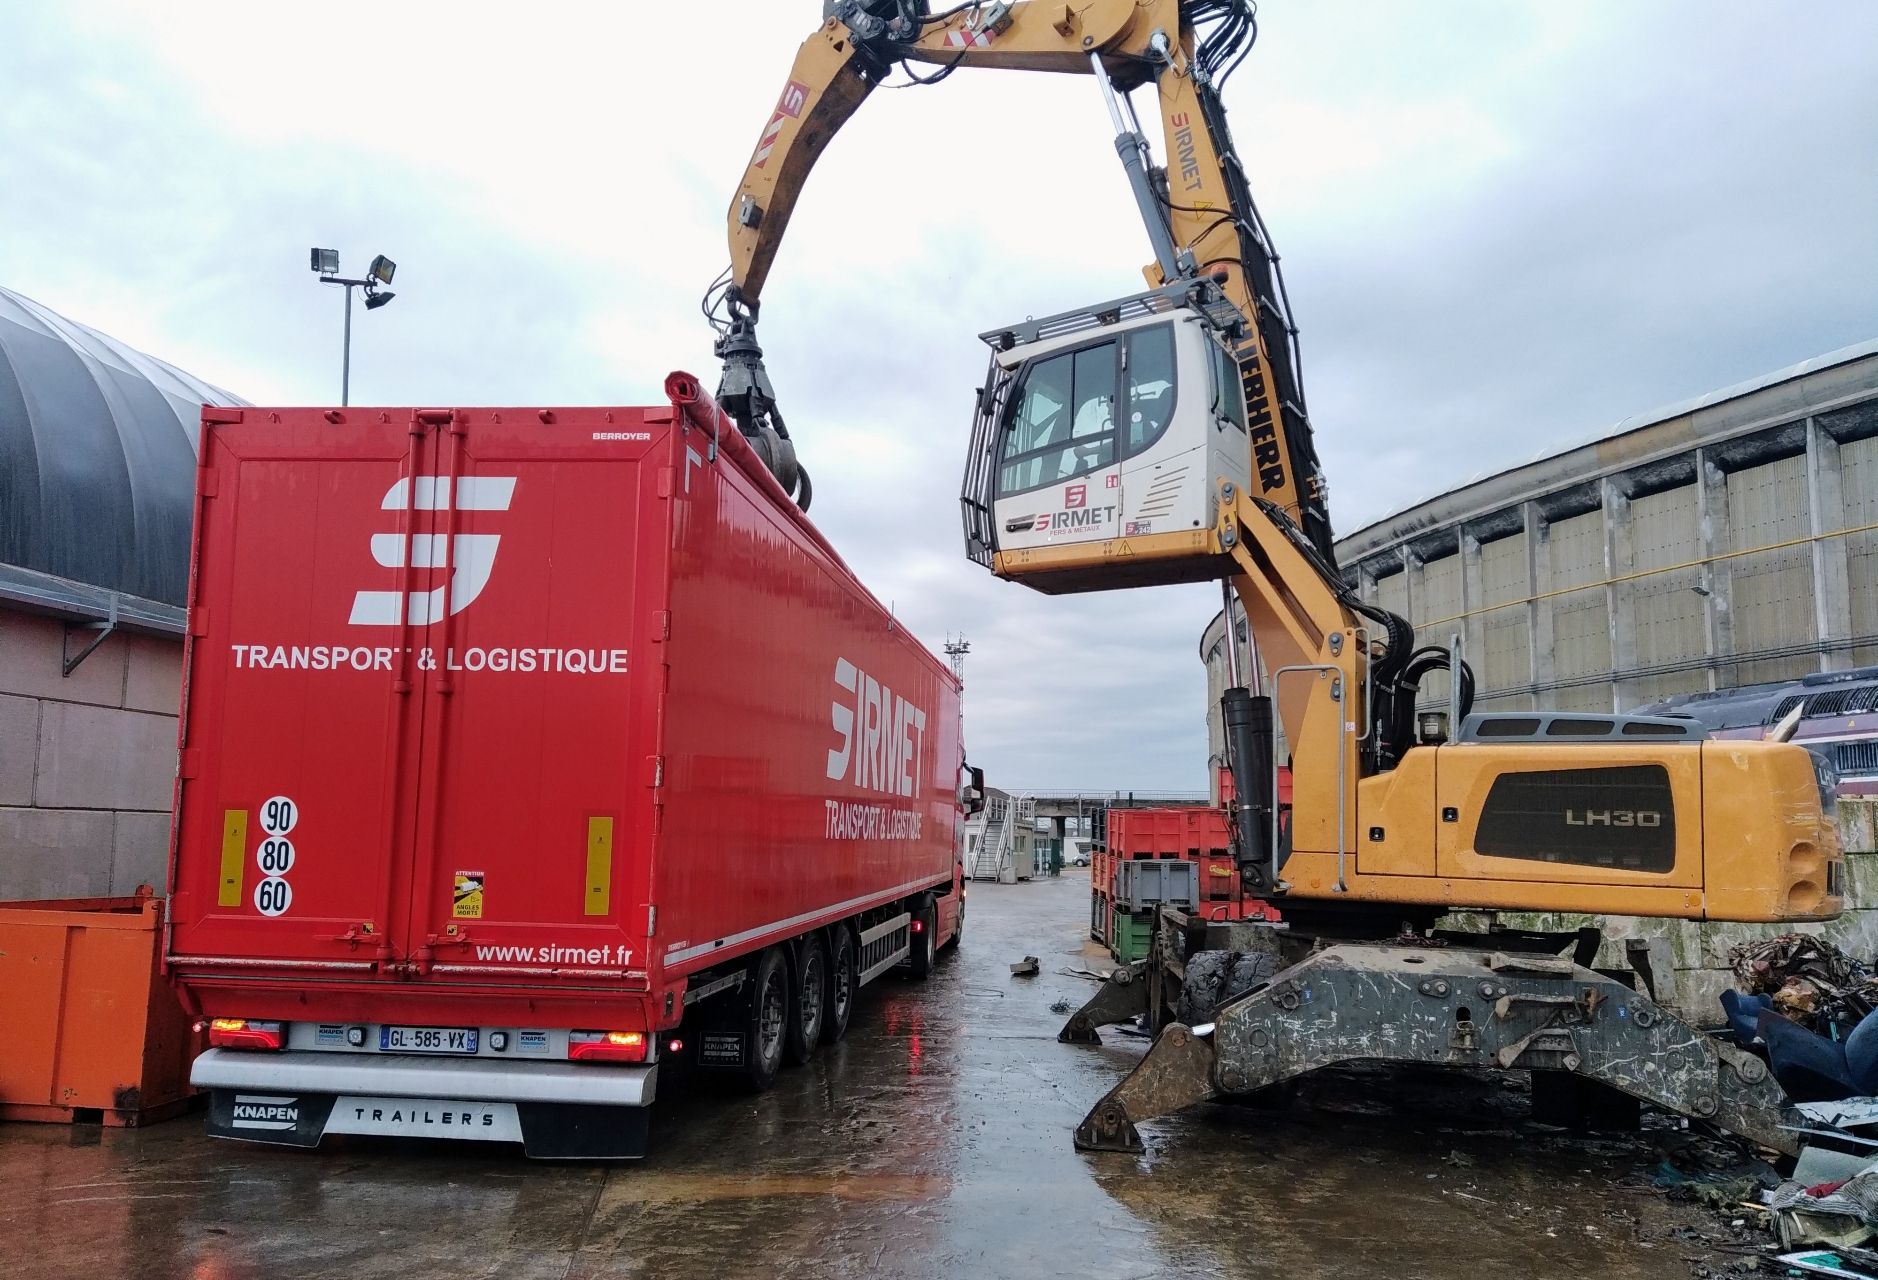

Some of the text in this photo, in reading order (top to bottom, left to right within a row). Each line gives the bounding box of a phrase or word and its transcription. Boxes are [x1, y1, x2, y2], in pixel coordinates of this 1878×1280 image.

[1171, 112, 1202, 191] SIRMET
[592, 432, 651, 440] BERROYER
[1035, 505, 1117, 532] SIRMET
[417, 647, 437, 671] &
[447, 647, 628, 674] LOGISTIQUE
[826, 656, 926, 799] SIRMET
[267, 801, 291, 831] 90
[825, 799, 922, 841] TRANSPORT & LOGISTIQUE
[1566, 809, 1660, 827] LH30
[262, 841, 289, 871] 80
[259, 881, 286, 911] 60
[476, 943, 633, 966] www.sirmet.fr
[390, 1030, 466, 1049] GL-585-VX
[704, 1042, 740, 1051] KNAPEN
[233, 1105, 494, 1126] KNAPEN TRAILERS
